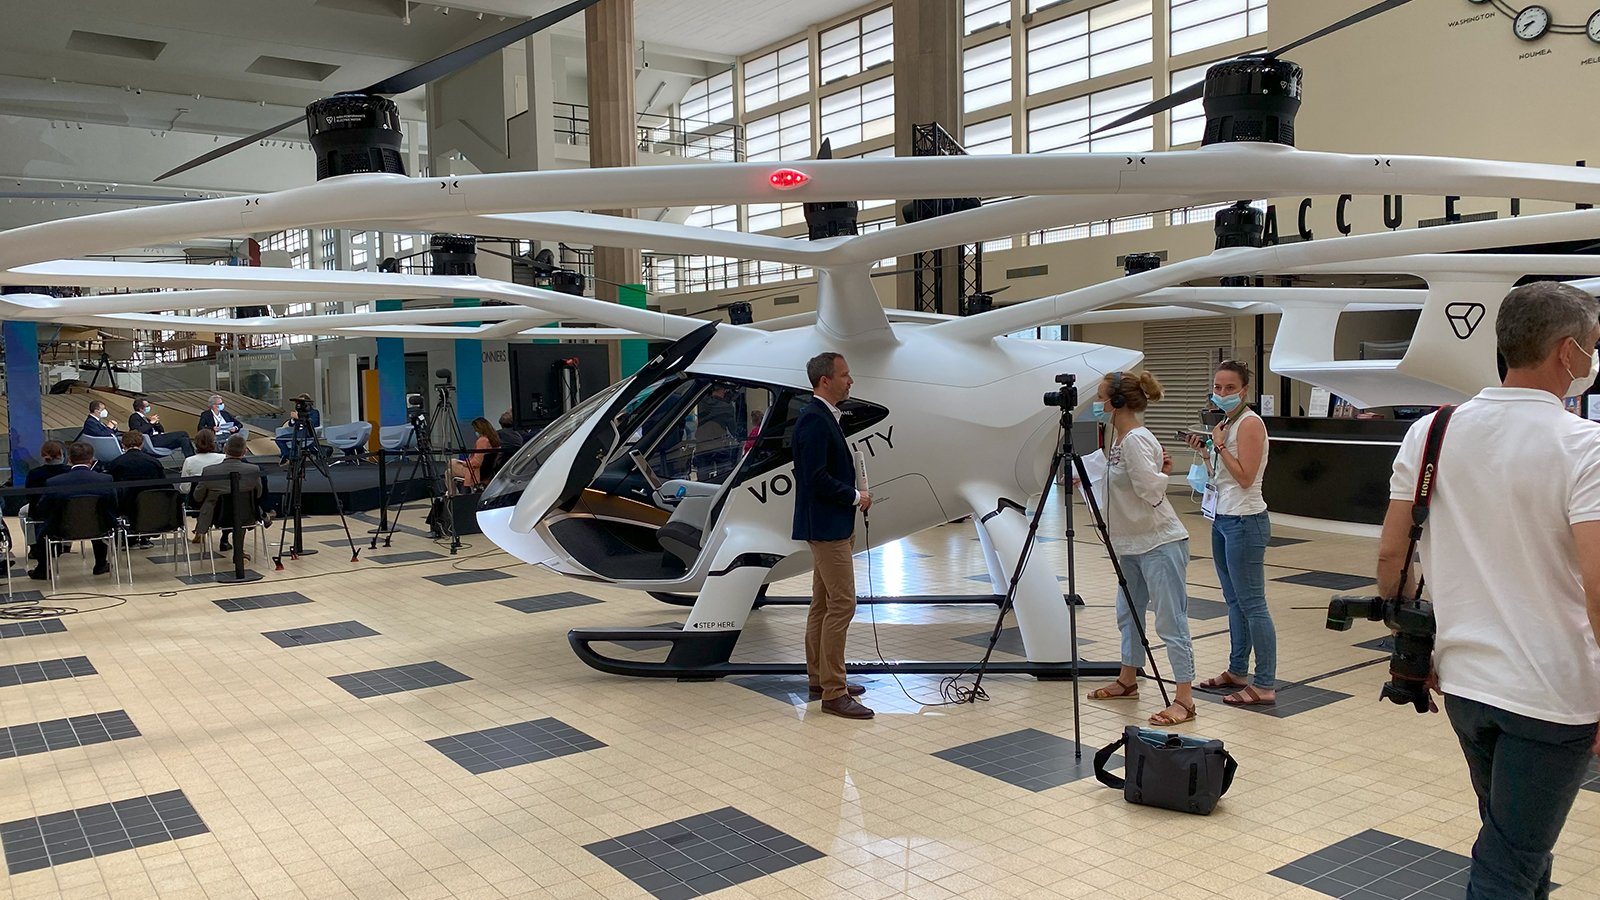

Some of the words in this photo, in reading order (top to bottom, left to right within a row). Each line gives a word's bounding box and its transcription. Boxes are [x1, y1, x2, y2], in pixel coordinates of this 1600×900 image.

[1448, 12, 1496, 28] WASHINGTON
[1518, 48, 1552, 60] NOUMEA
[1421, 463, 1433, 496] Canon
[699, 621, 716, 629] STEP
[717, 620, 736, 628] HERE
